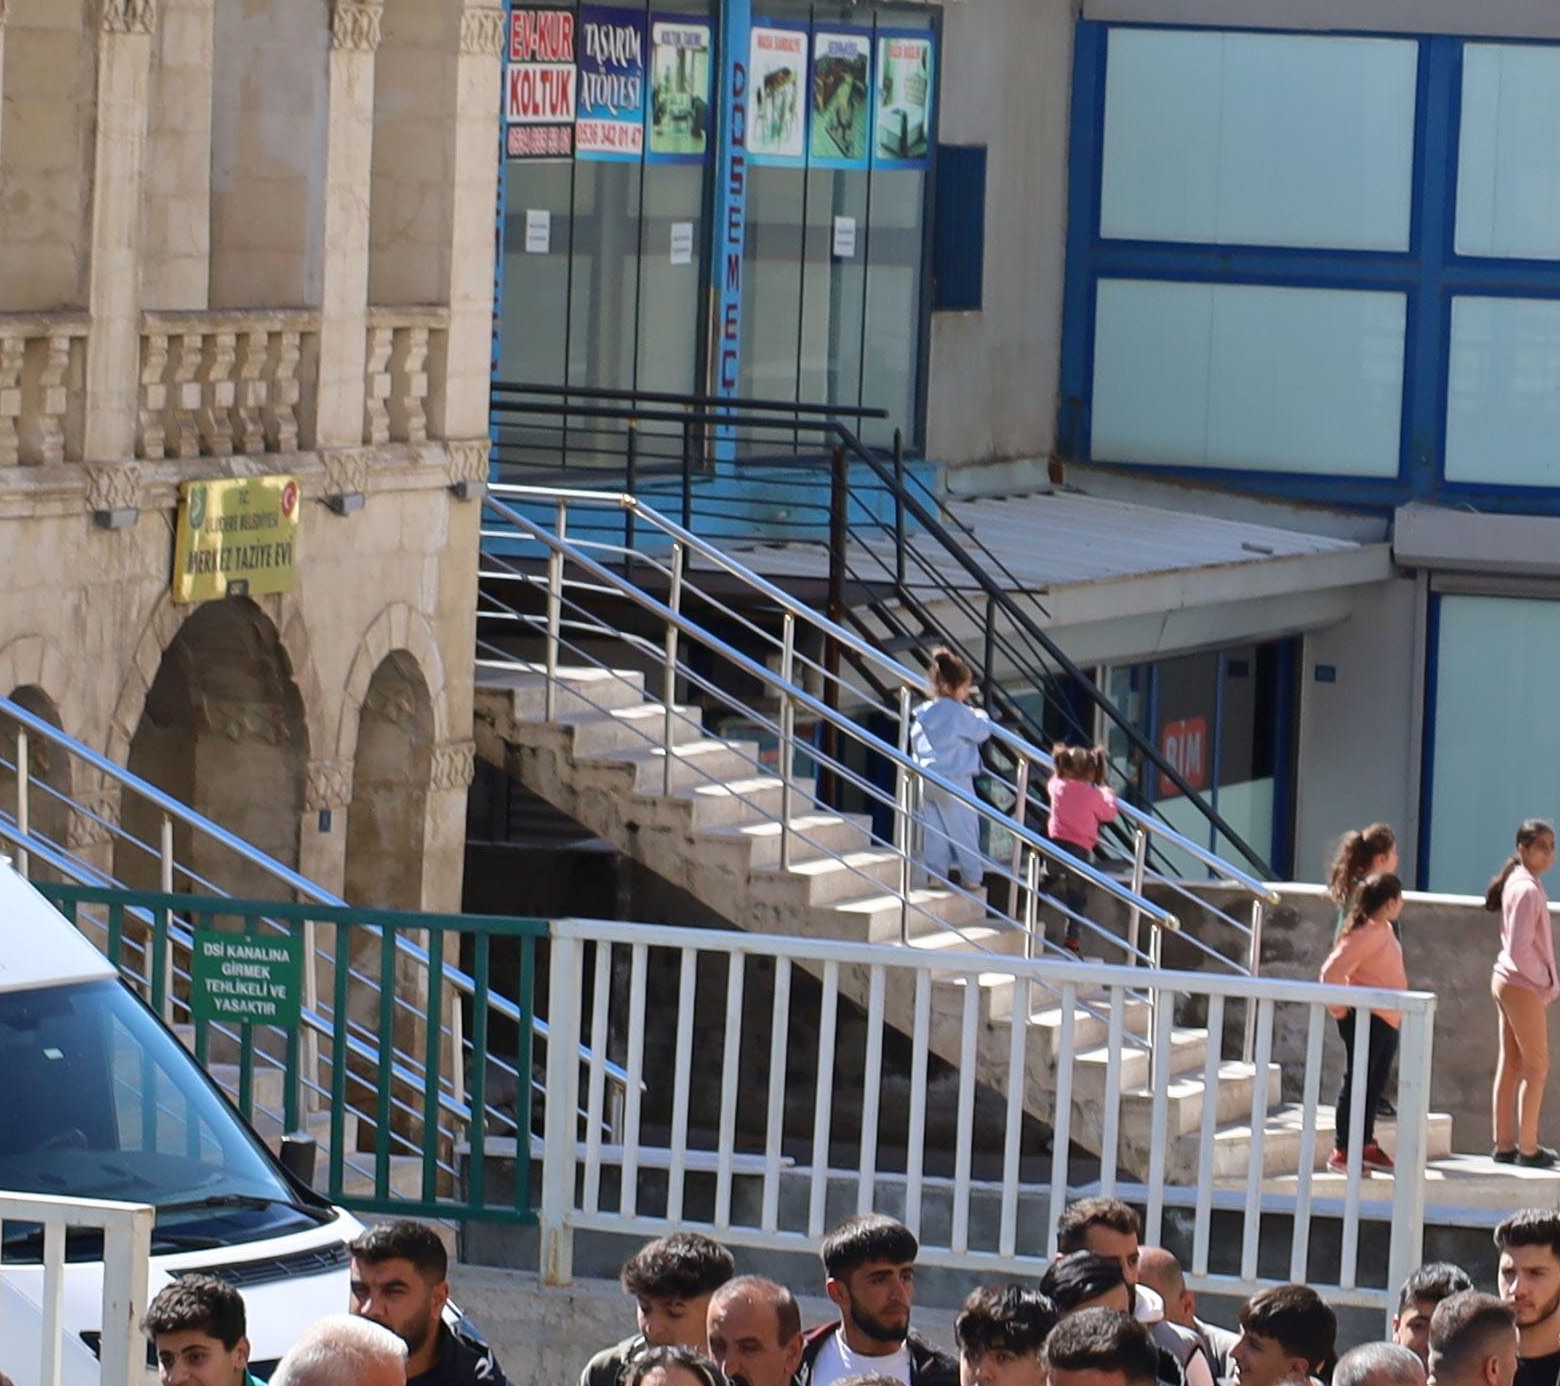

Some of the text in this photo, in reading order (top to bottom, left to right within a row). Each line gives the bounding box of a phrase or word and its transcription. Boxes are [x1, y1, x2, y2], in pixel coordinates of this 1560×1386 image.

[510, 69, 571, 117] KOLTUK
[234, 538, 272, 570] TAZİYE
[203, 941, 290, 962] DSİ KANALINA
[221, 960, 271, 980] GİRMEK
[204, 978, 287, 999] TEHLİKELİ VE
[214, 997, 276, 1016] YASAKTIR
